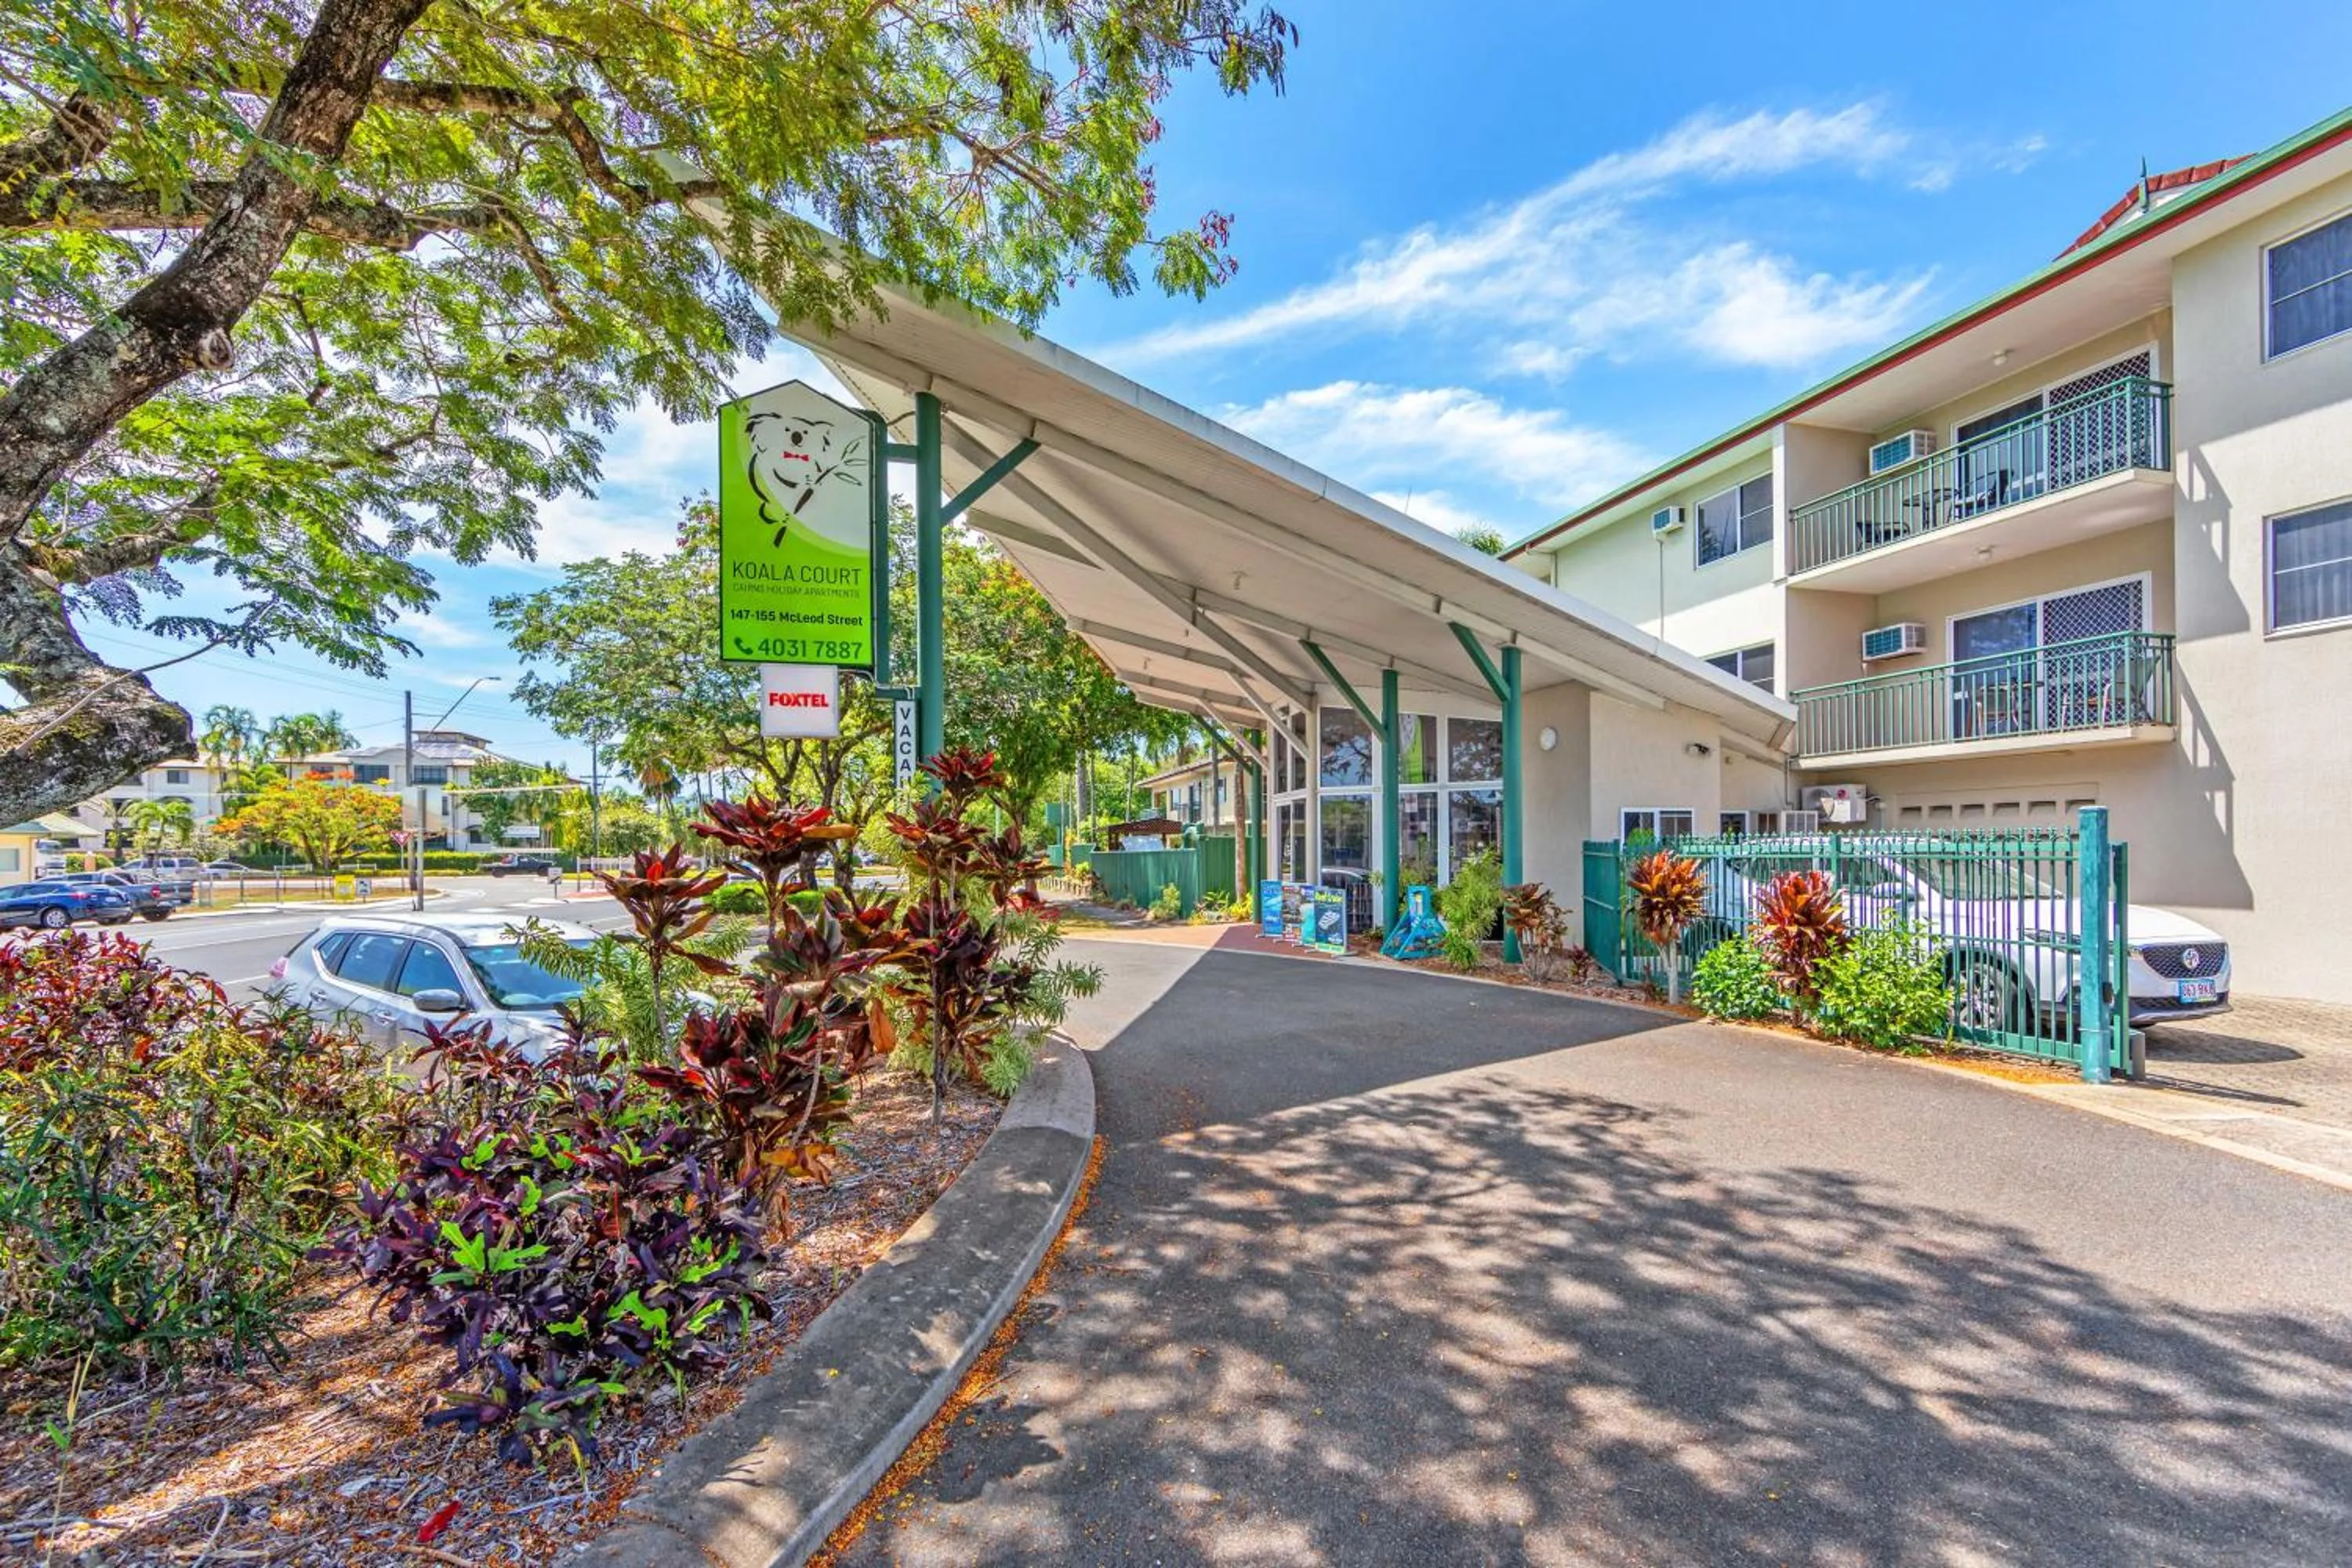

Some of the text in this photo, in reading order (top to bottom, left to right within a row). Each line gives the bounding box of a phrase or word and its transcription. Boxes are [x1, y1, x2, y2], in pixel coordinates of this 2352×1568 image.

[733, 561, 861, 585] KOALA COURT
[804, 590, 860, 599] APARTMENTS
[731, 609, 863, 627] 147-155 McLeod Street
[757, 638, 862, 659] 4031 7887
[769, 693, 829, 707] FOXTEL
